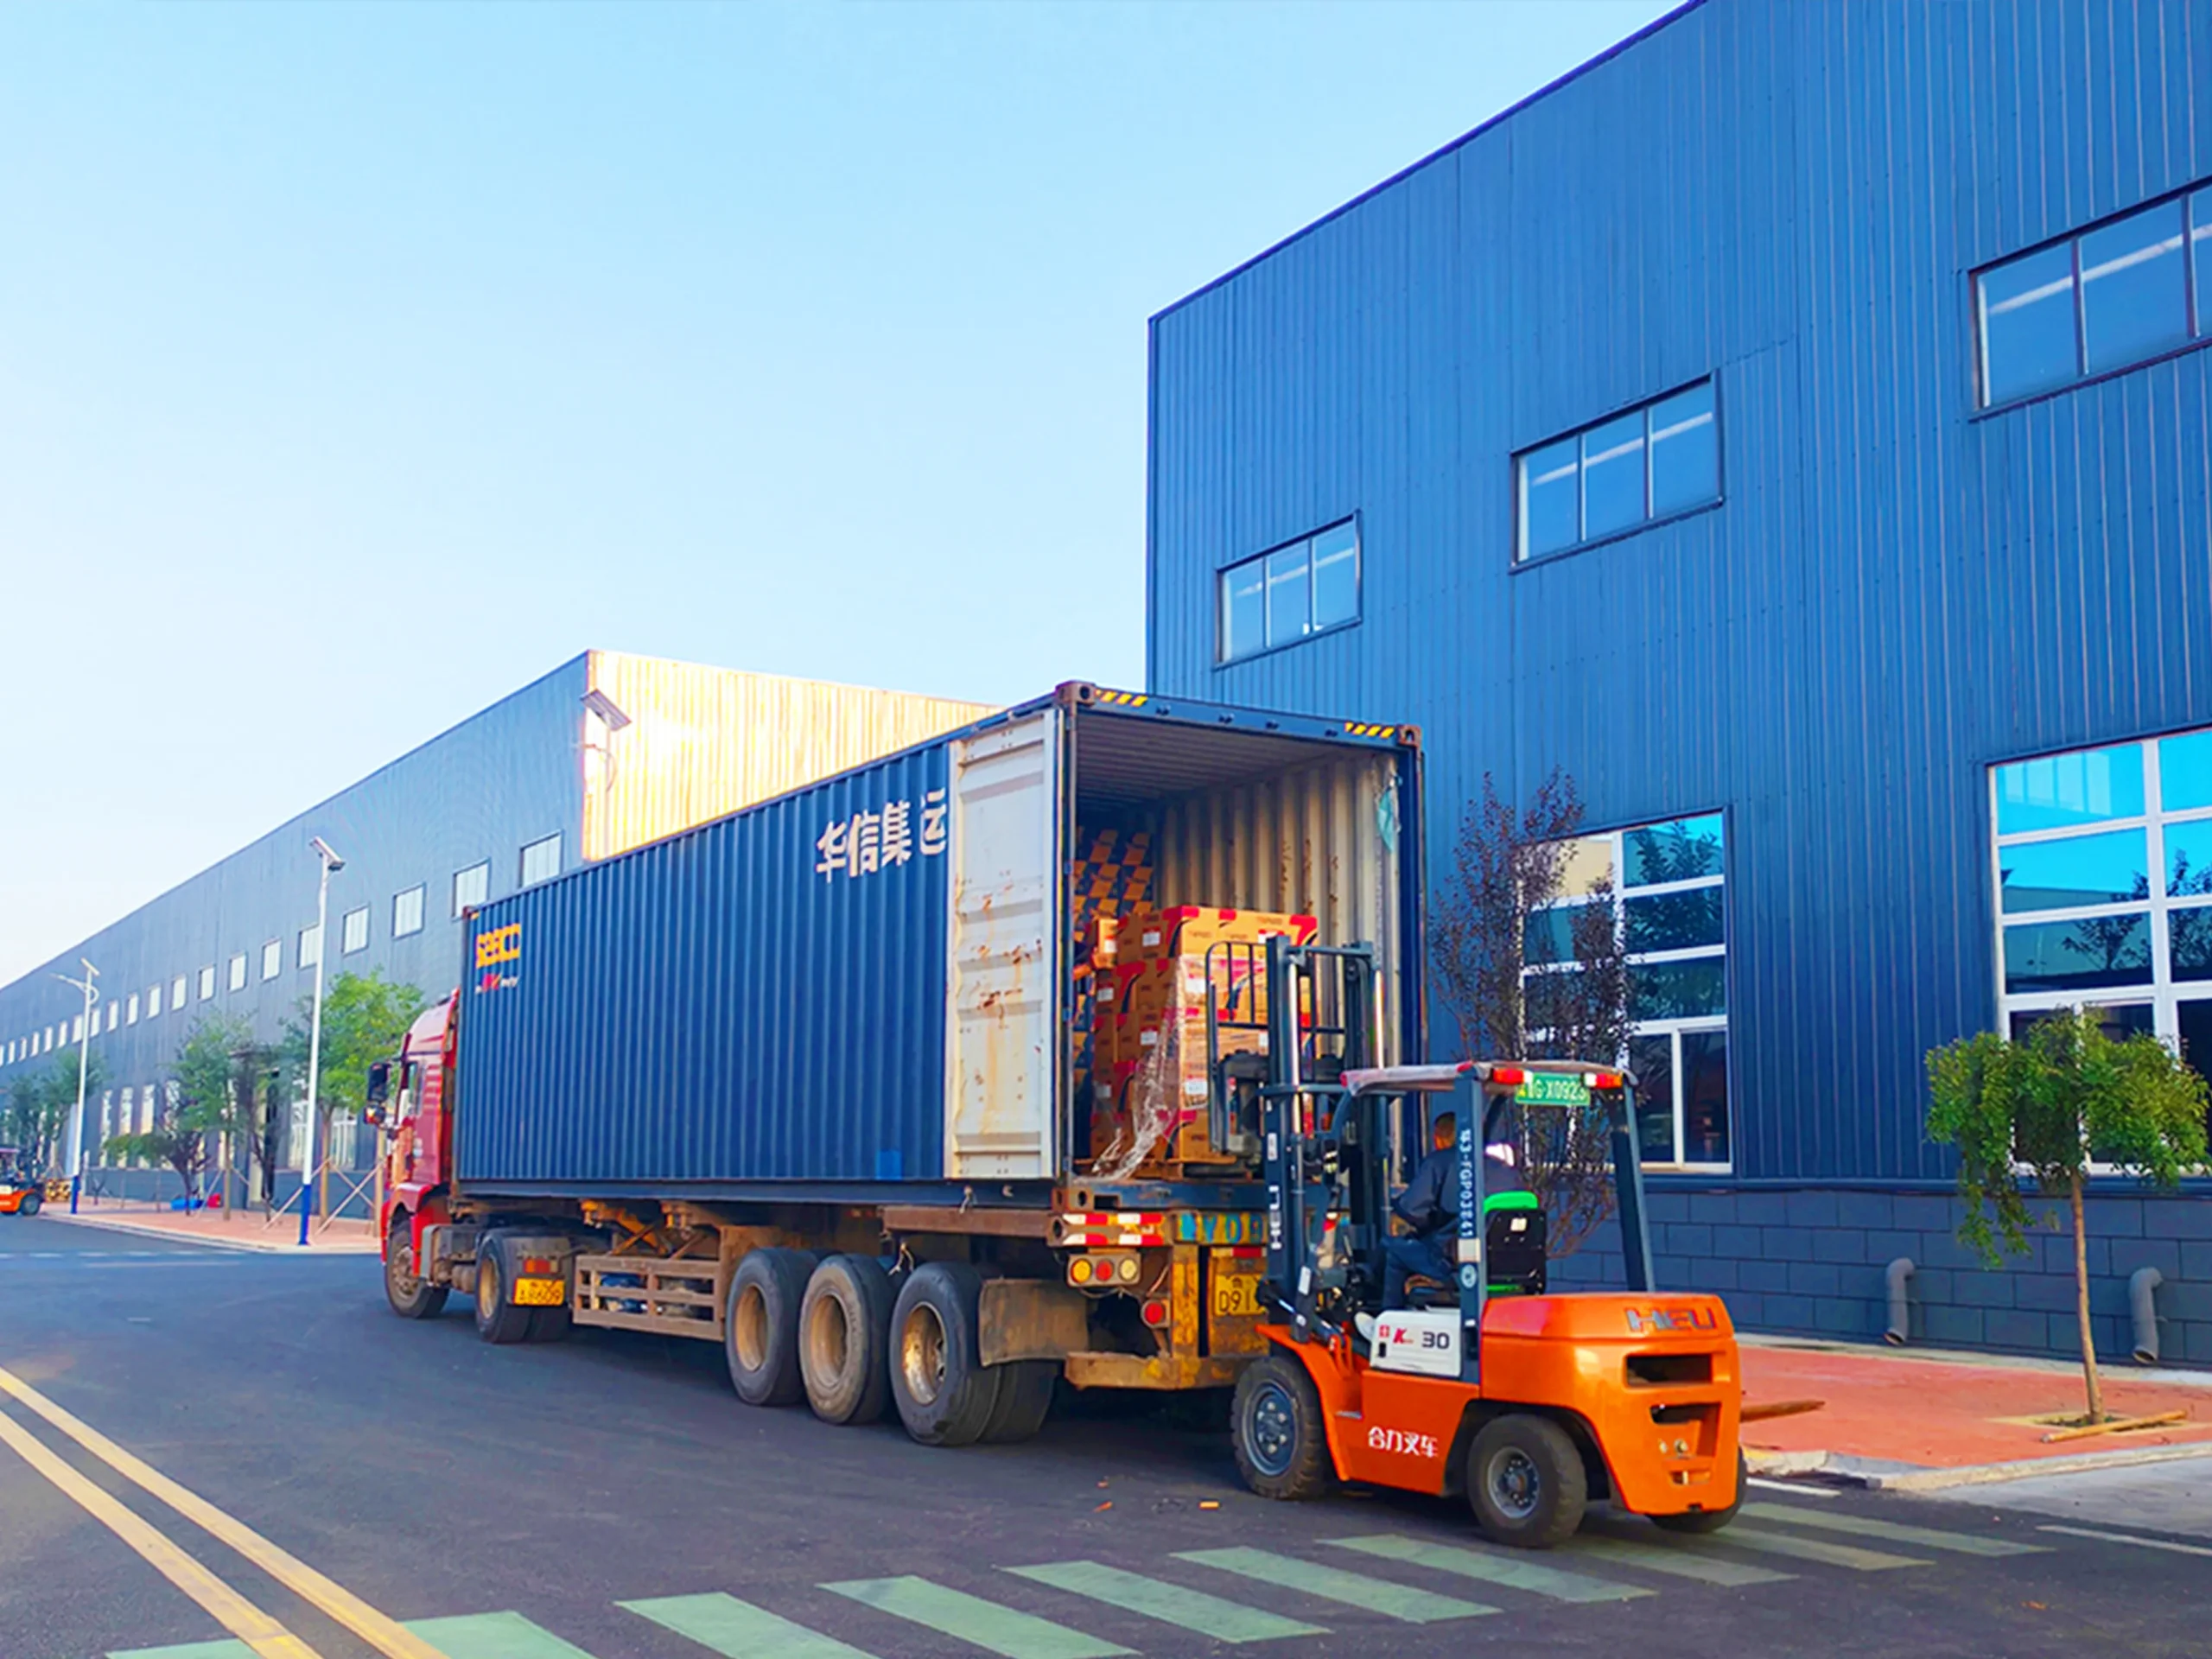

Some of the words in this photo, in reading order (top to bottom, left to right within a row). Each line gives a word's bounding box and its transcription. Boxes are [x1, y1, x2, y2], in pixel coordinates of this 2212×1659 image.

[1219, 1290, 1261, 1312] D91
[1421, 1332, 1450, 1350] 30
[1368, 1427, 1439, 1458] 合力叉车
